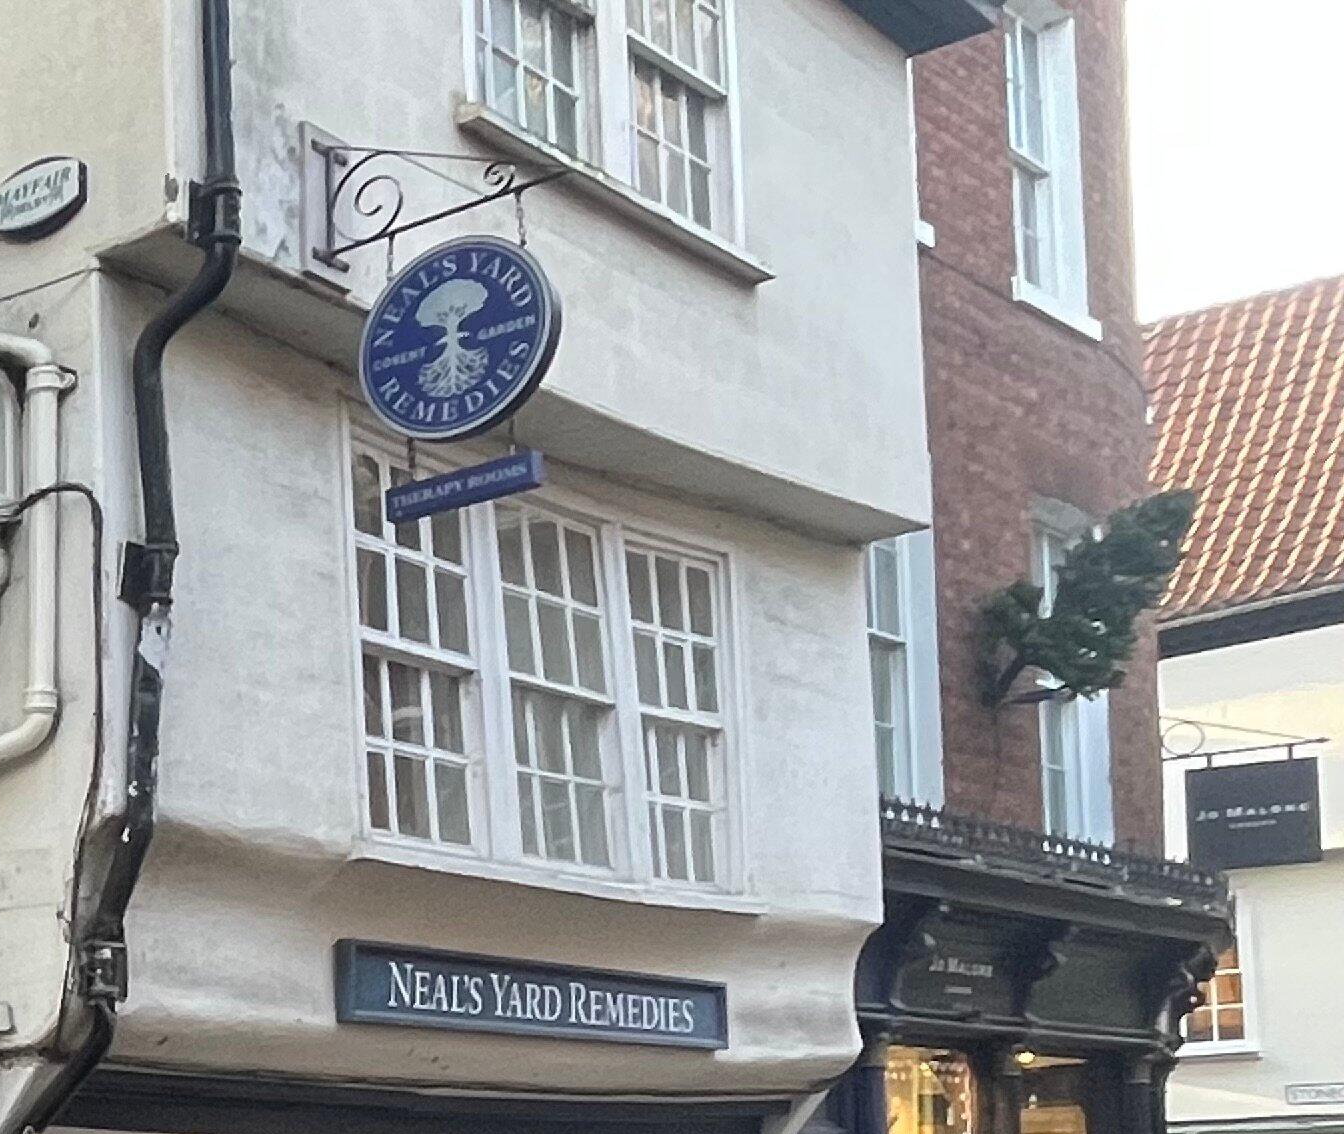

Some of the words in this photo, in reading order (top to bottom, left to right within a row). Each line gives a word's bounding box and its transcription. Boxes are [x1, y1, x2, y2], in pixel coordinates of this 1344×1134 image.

[372, 254, 459, 349] NEAL'S
[469, 251, 533, 309] YARD
[476, 313, 537, 341] GARDEN
[379, 341, 530, 423] REMEDIES
[392, 480, 463, 509] THERAPY
[467, 461, 529, 490] ROOMS
[388, 961, 484, 1016] NEAL'S
[490, 972, 562, 1022] YARD
[568, 981, 695, 1034] REMEDIES
